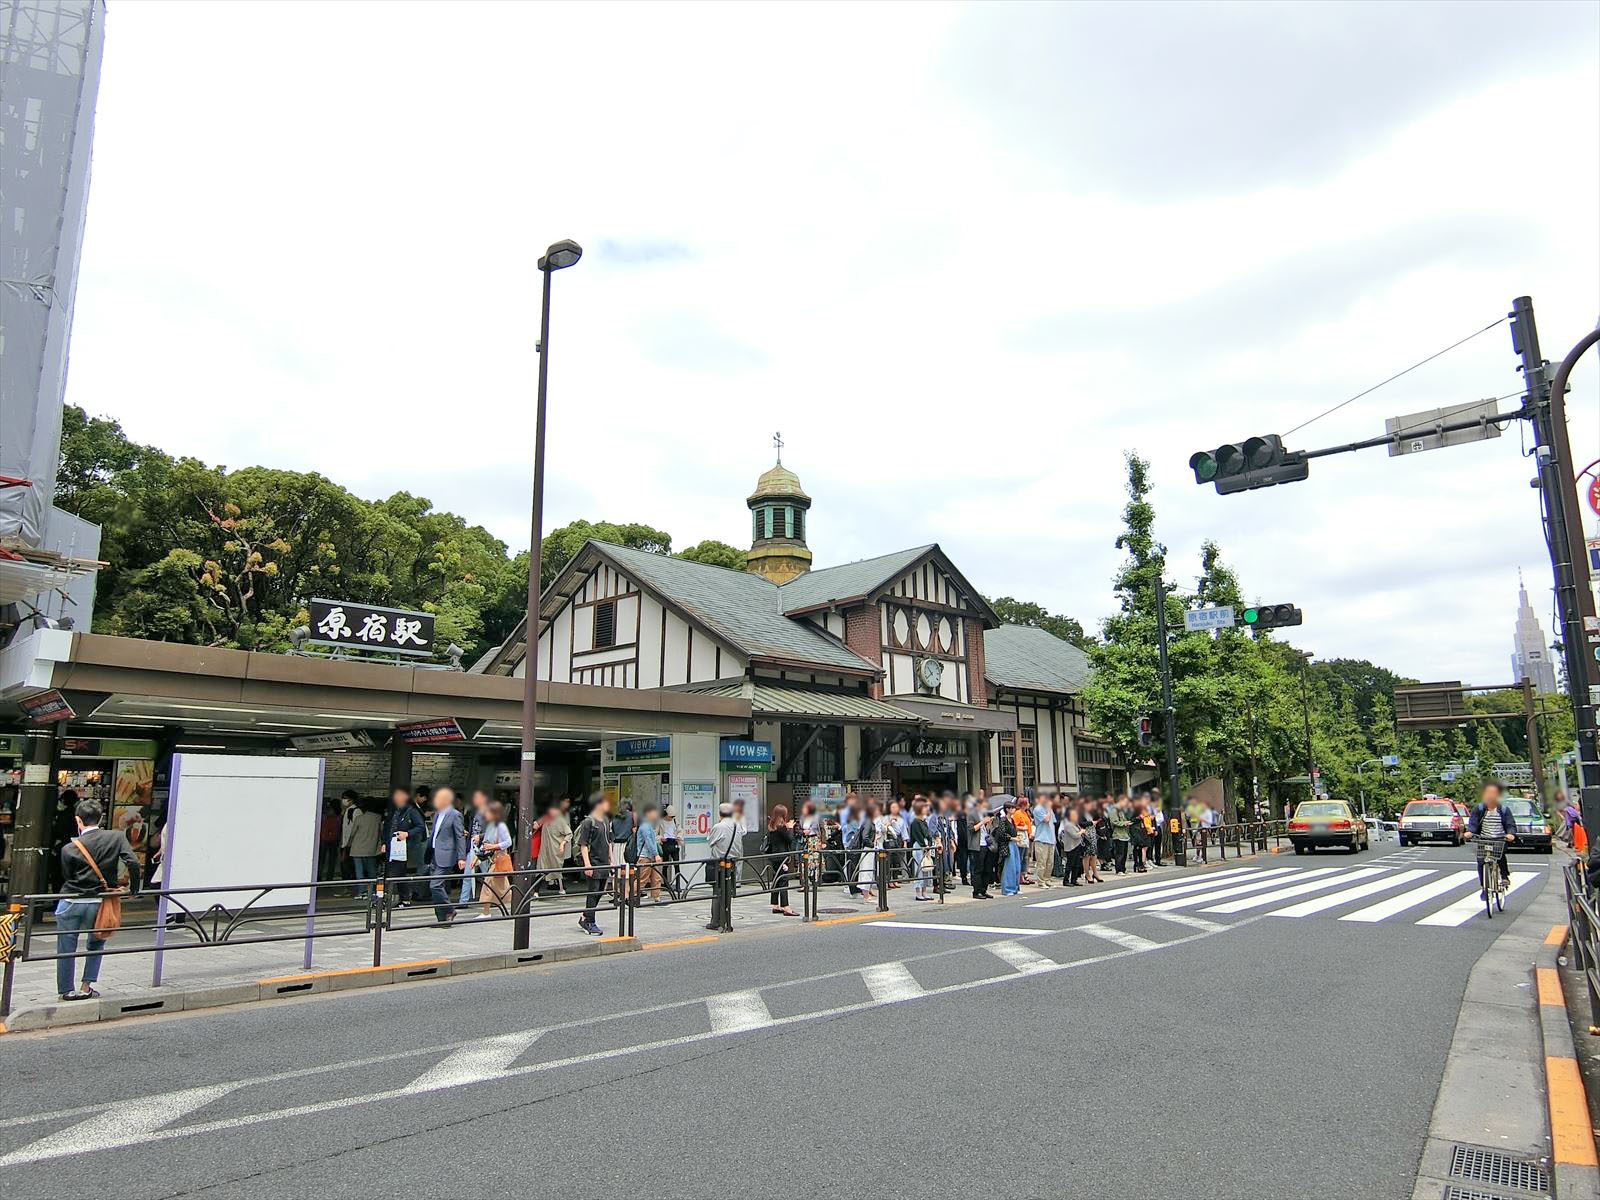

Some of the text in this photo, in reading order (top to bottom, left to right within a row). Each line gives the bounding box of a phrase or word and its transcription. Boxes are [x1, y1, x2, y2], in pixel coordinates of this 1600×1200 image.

[318, 607, 428, 645] 原宿駅
[1188, 609, 1229, 622] 原宿駅前
